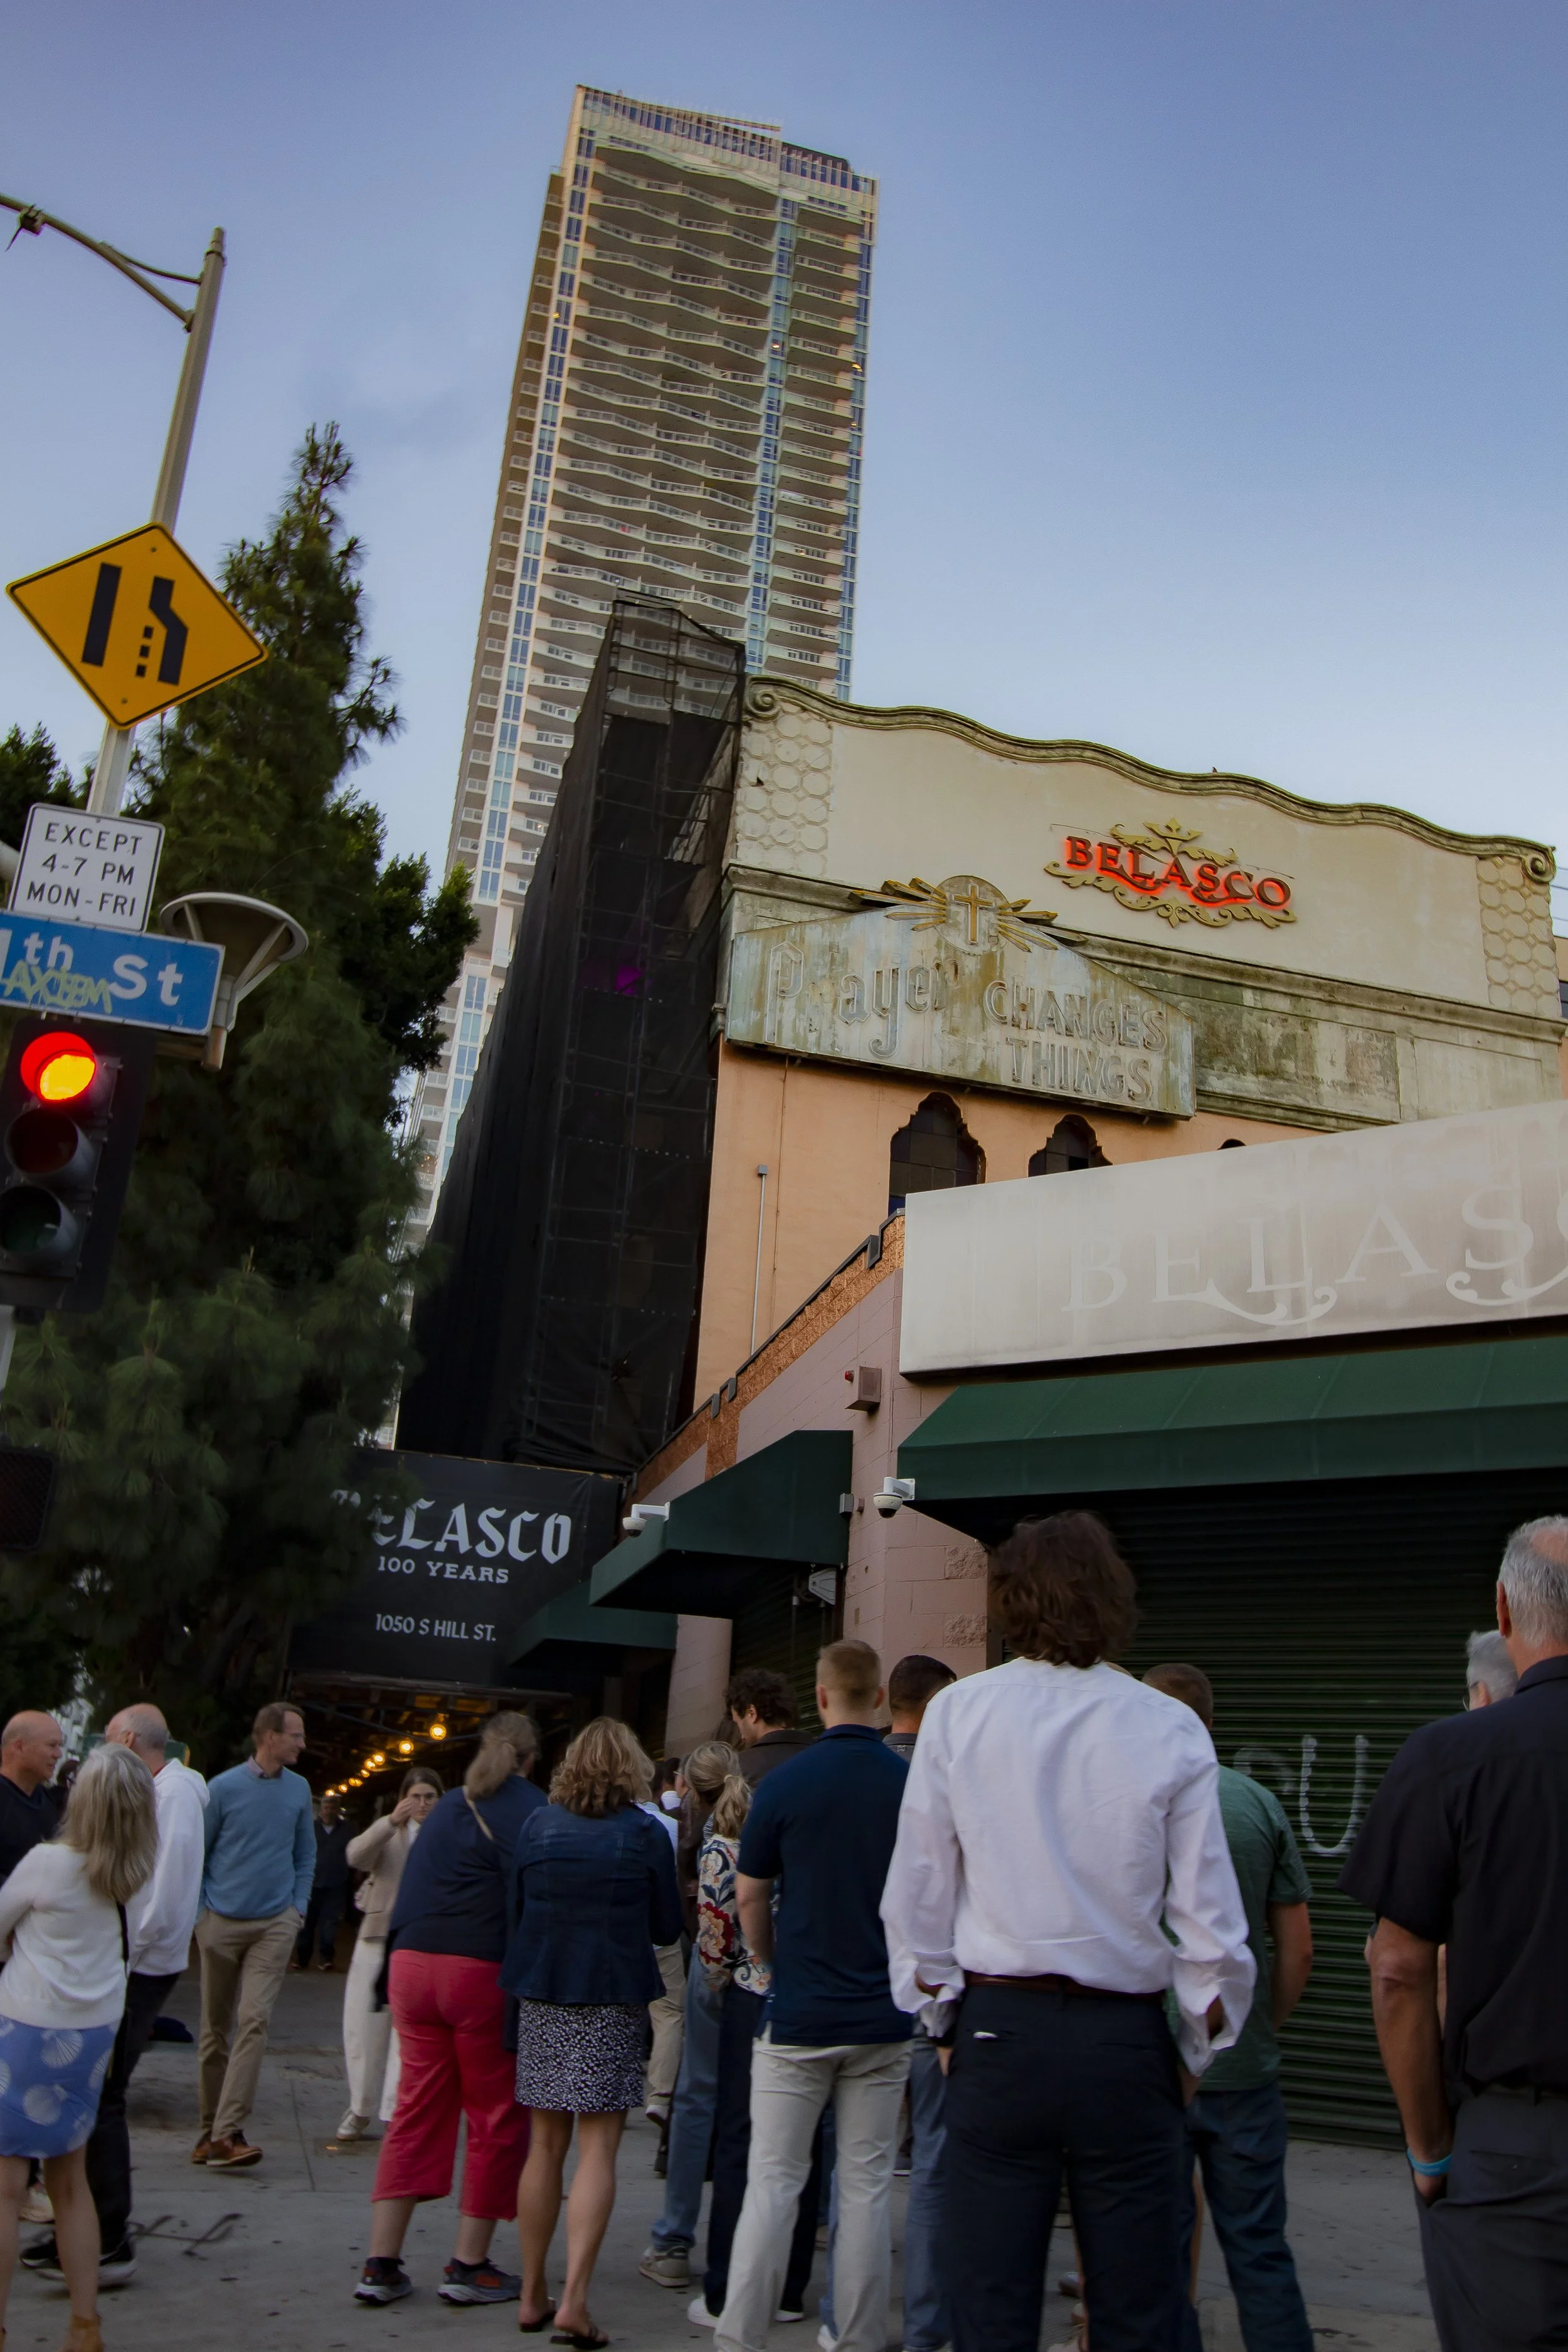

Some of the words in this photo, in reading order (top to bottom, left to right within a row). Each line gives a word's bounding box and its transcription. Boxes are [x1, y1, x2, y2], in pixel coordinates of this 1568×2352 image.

[45, 822, 143, 856] EXCEPT
[41, 852, 88, 877] 4-7
[100, 861, 135, 886] PM
[1066, 835, 1292, 907] BELASCO
[108, 954, 183, 1006] St
[983, 980, 1167, 1052] CHANGES
[1006, 1036, 1152, 1102] THINGS
[1061, 1183, 1568, 1326] BELAS
[331, 1489, 572, 1564] ELASCO
[378, 1555, 416, 1574] 100
[426, 1560, 509, 1584] YEARS
[376, 1614, 415, 1634] 1050
[418, 1618, 430, 1635] S
[433, 1619, 469, 1640] HILL
[473, 1624, 497, 1642] ST.
